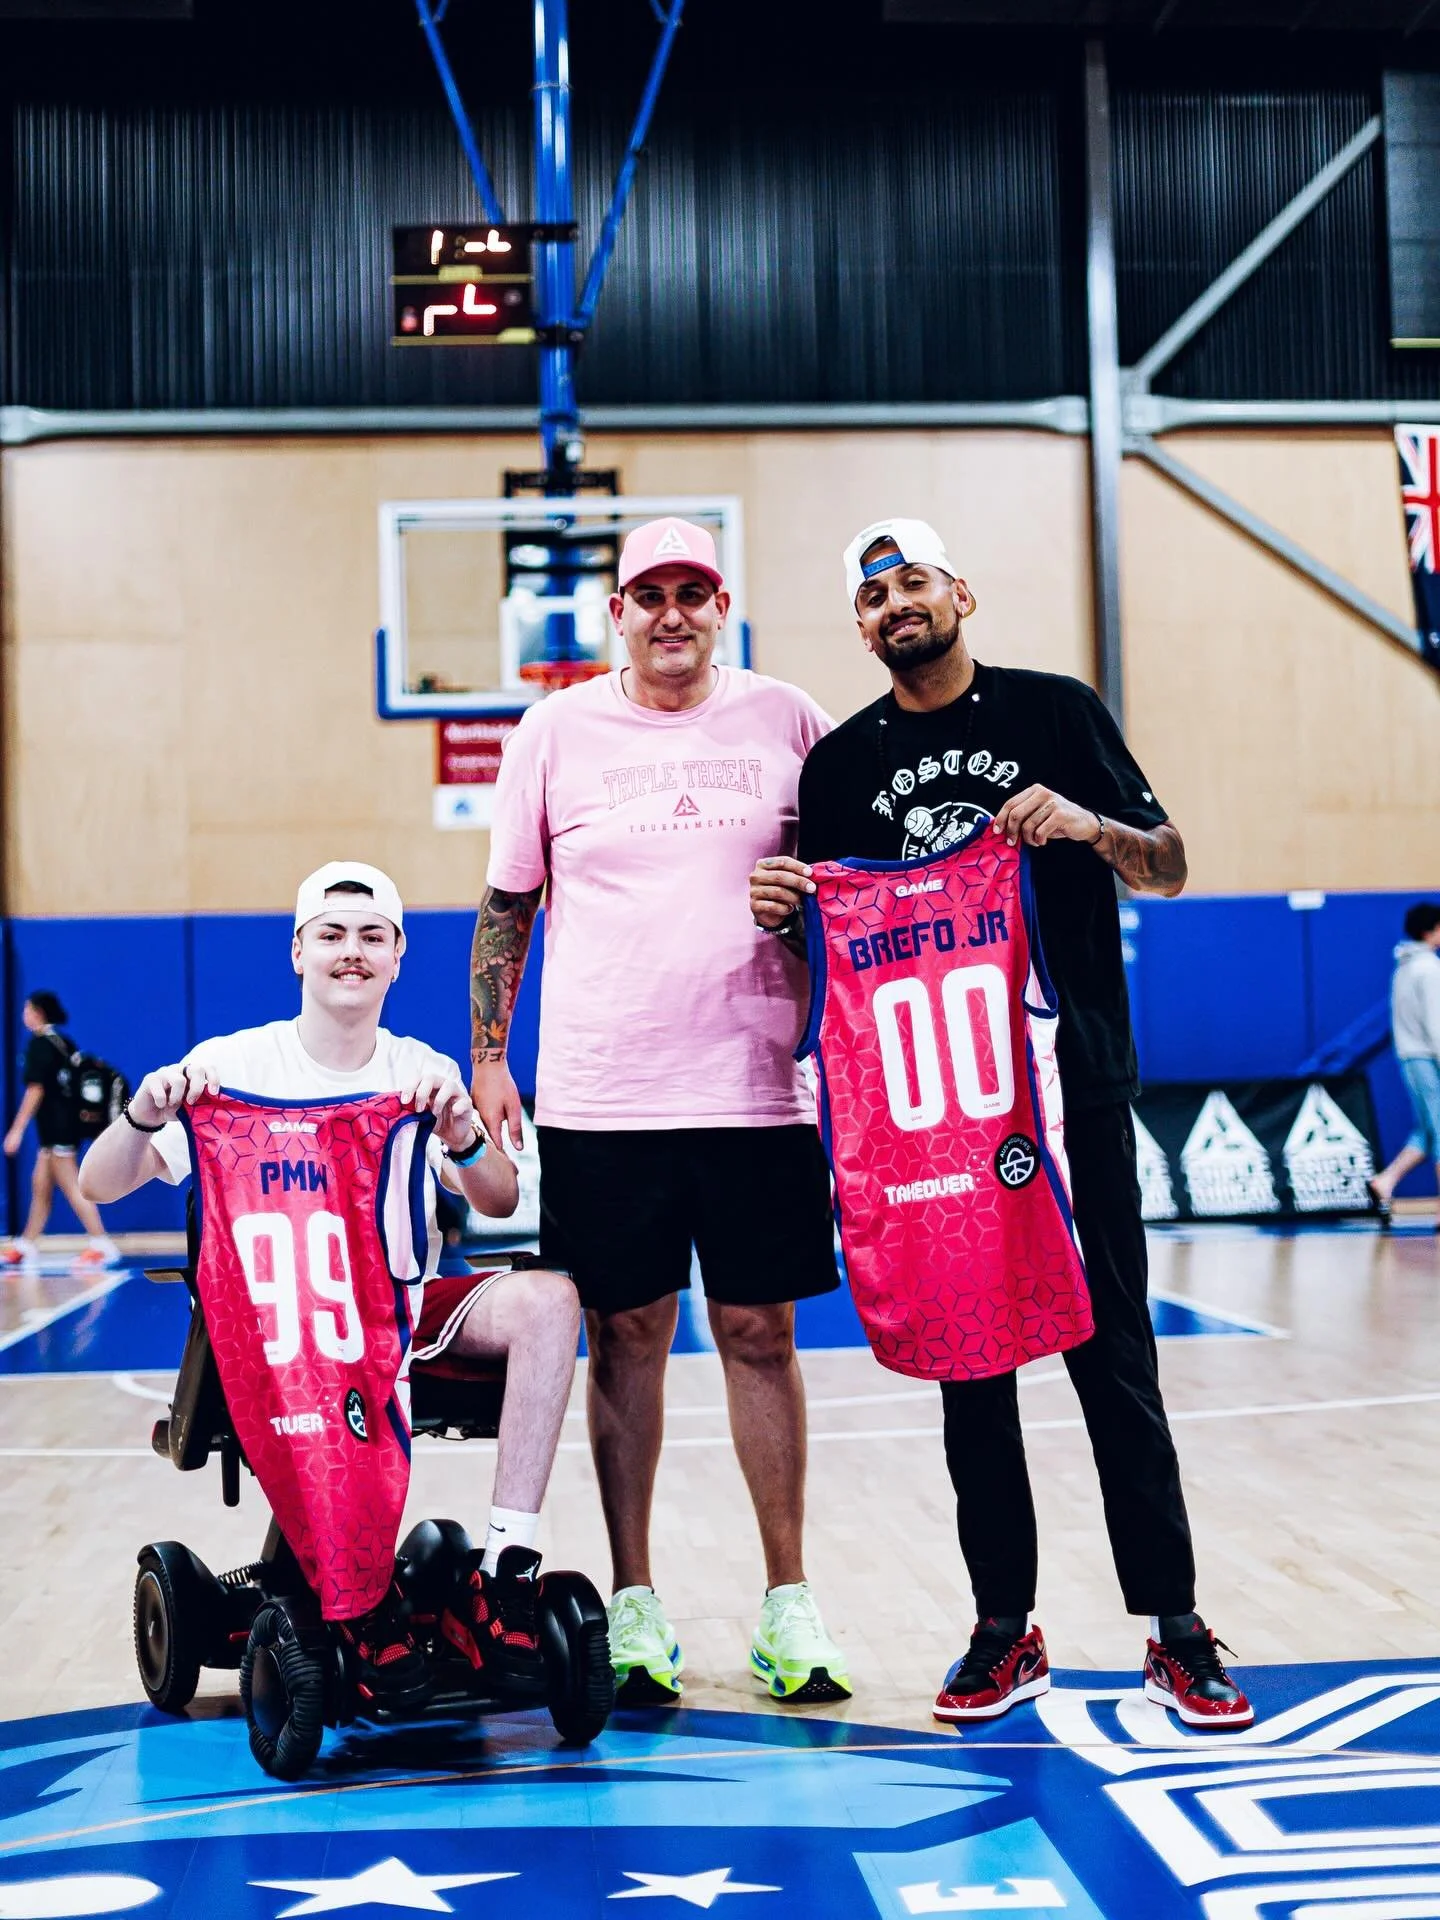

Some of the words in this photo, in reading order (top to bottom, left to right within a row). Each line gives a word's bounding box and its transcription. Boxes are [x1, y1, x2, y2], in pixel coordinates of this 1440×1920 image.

[602, 762, 677, 810] TRIPLE
[683, 759, 762, 799] THREAT
[630, 818, 746, 833] TOURNAMENTS
[895, 879, 943, 898] GAME
[872, 963, 1016, 1132] 00
[268, 1121, 318, 1135] GAME
[260, 1159, 328, 1195] PMW
[232, 1210, 365, 1365] 99
